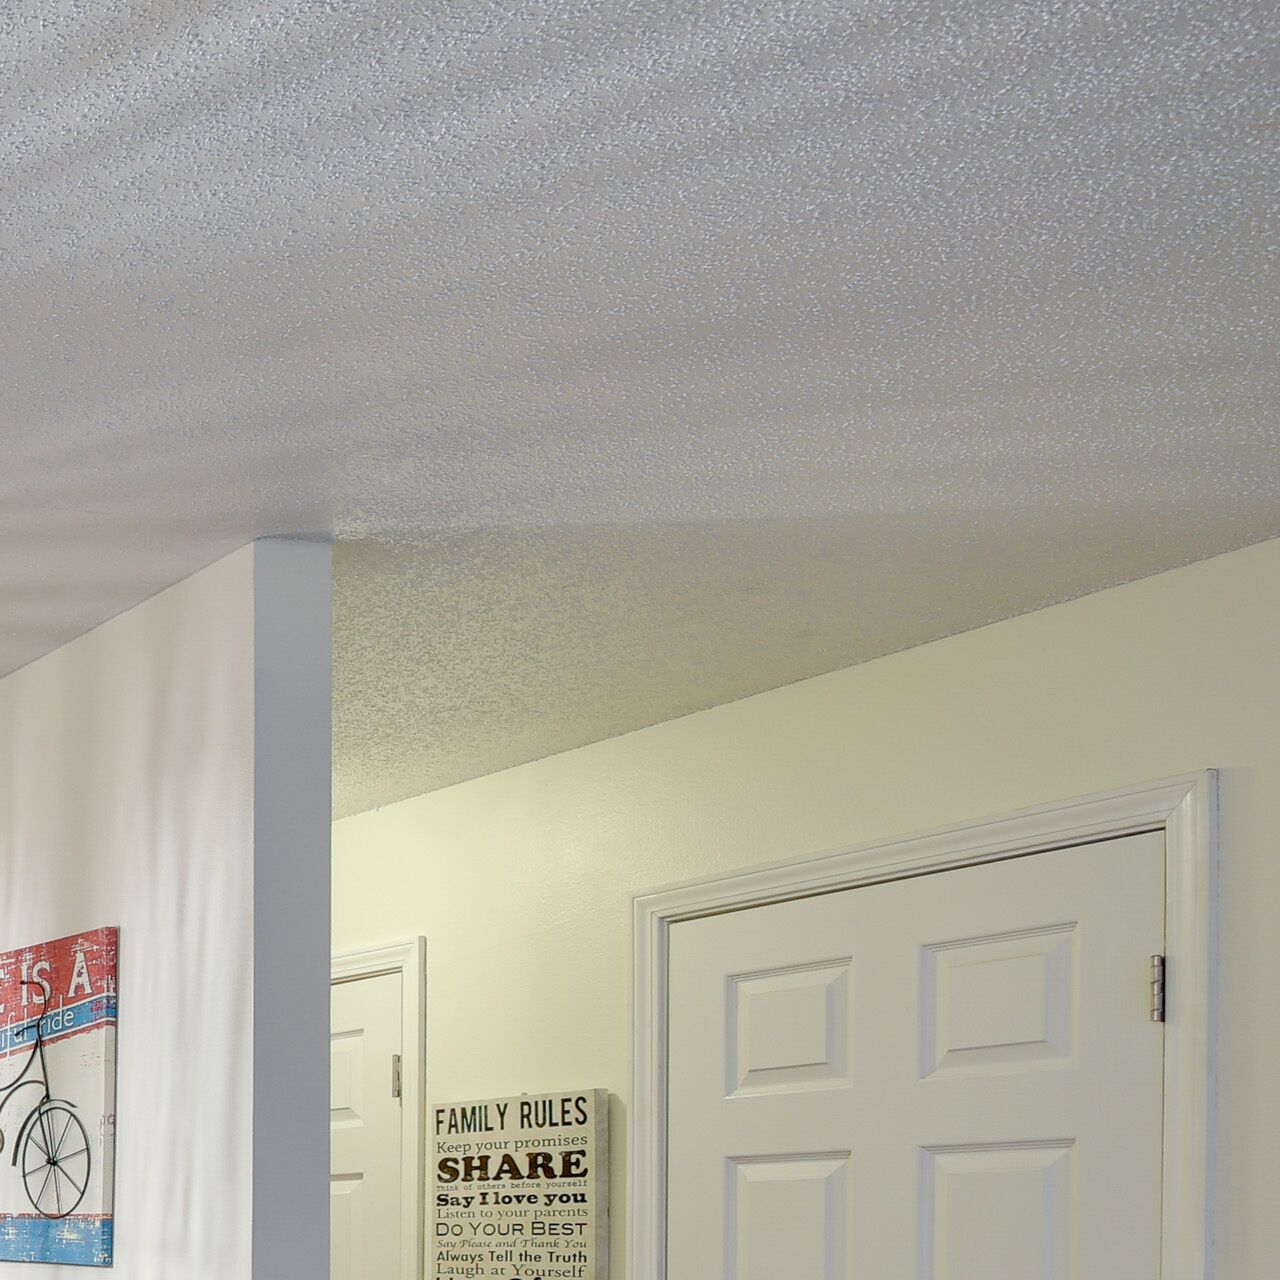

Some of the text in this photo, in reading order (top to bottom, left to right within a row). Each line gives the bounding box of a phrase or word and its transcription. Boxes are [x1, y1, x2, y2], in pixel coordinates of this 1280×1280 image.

[68, 950, 92, 997] A
[436, 1096, 587, 1135] FAMILY RULES
[437, 1134, 588, 1155] Keep your promises
[437, 1150, 588, 1183] SHARE
[546, 1180, 588, 1189] yourself
[436, 1192, 587, 1208] Say I love you
[437, 1207, 588, 1220] Listen to your parents
[469, 1222, 524, 1236] YOUR
[532, 1221, 588, 1236] BEST
[437, 1238, 587, 1249] Say Please and Thank You
[437, 1251, 587, 1264] Always Tell the Truth
[437, 1263, 587, 1278] Laugh at Yourself
